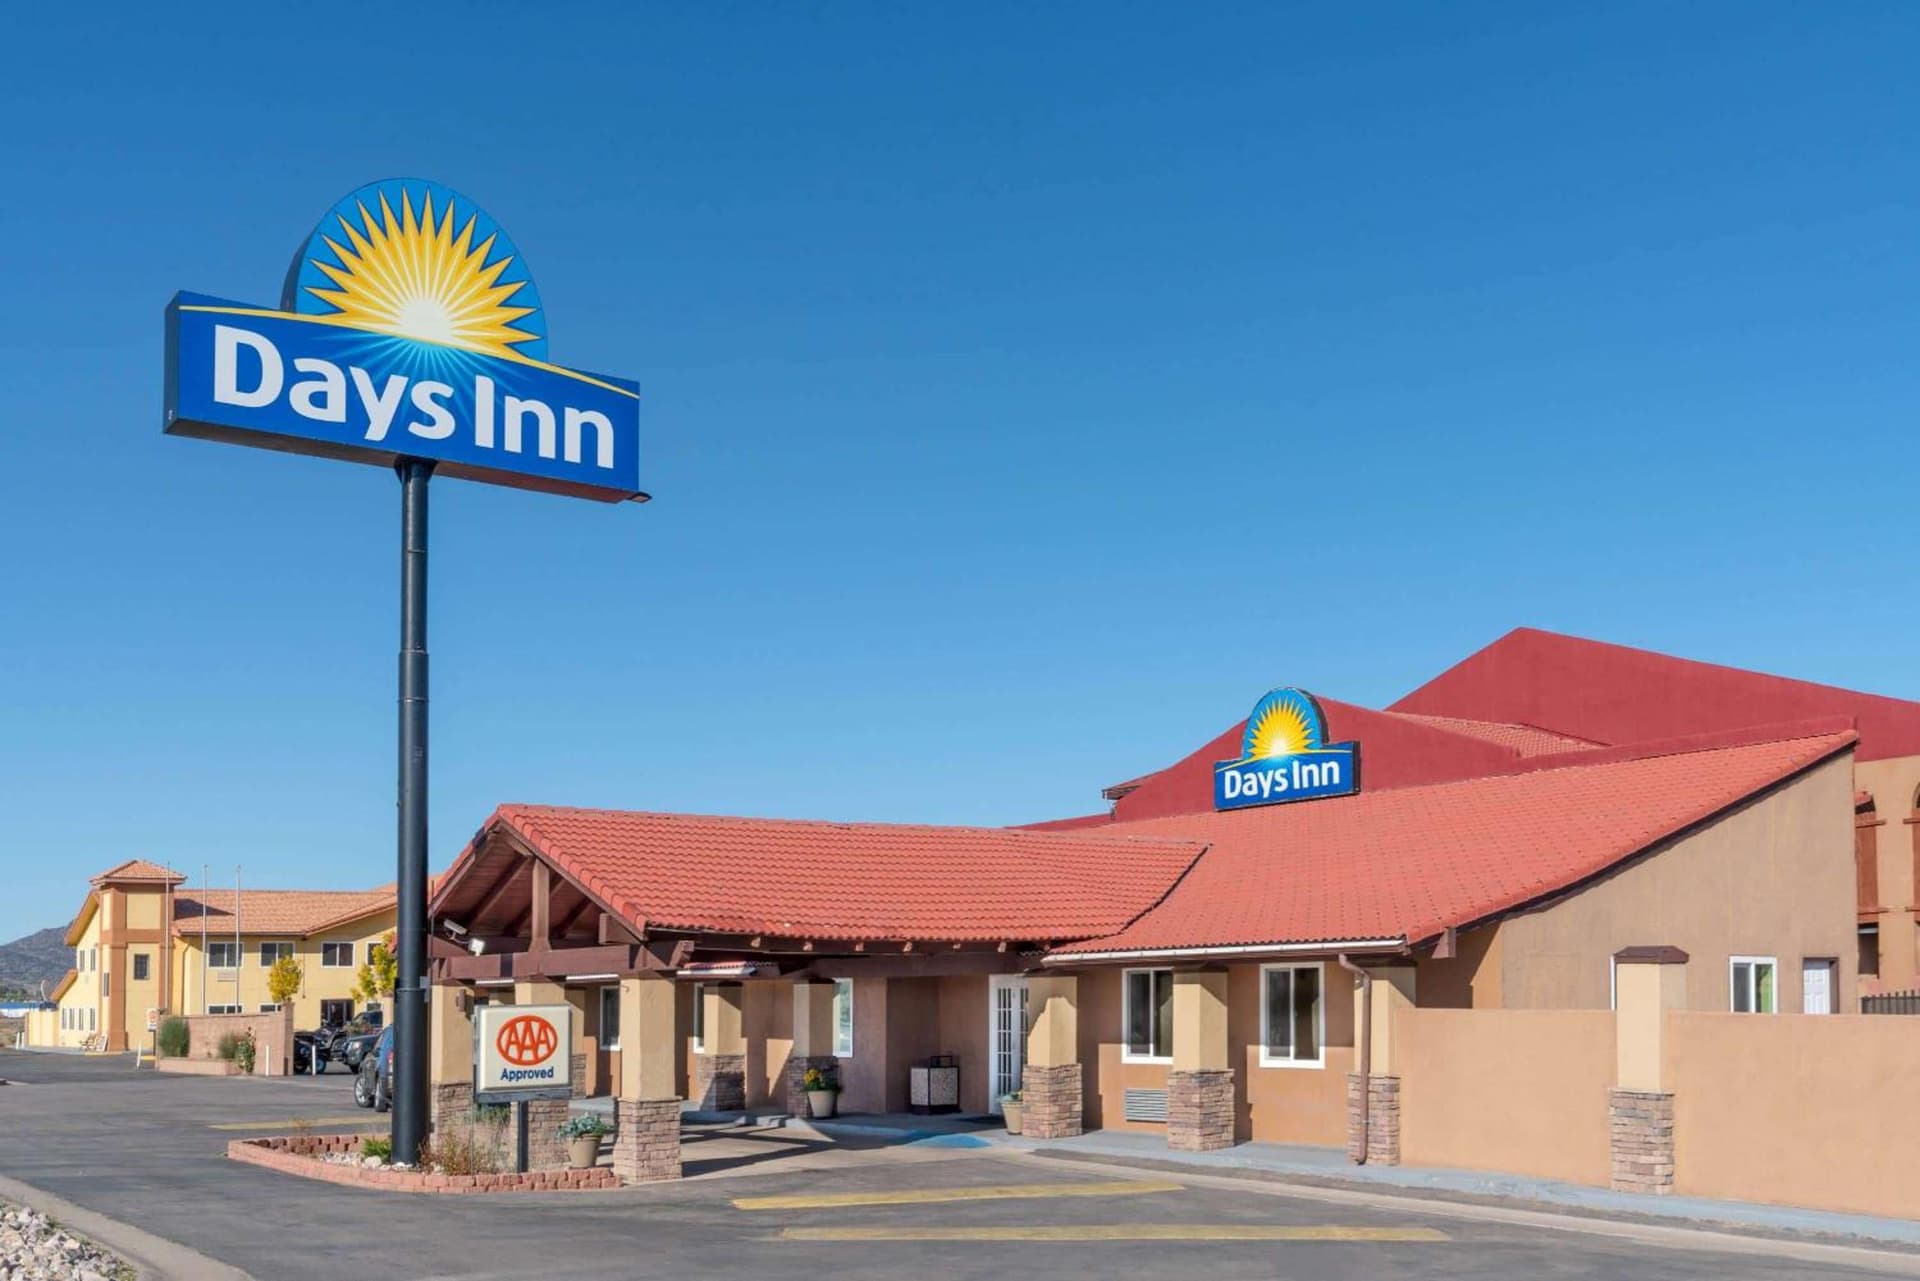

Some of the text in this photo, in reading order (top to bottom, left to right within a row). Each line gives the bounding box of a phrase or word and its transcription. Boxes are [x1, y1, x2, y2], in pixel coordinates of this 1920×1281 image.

[214, 325, 614, 468] Days Inn
[1224, 760, 1340, 799] Days Inn
[503, 1018, 554, 1063] AAA
[500, 1066, 554, 1082] Approved
